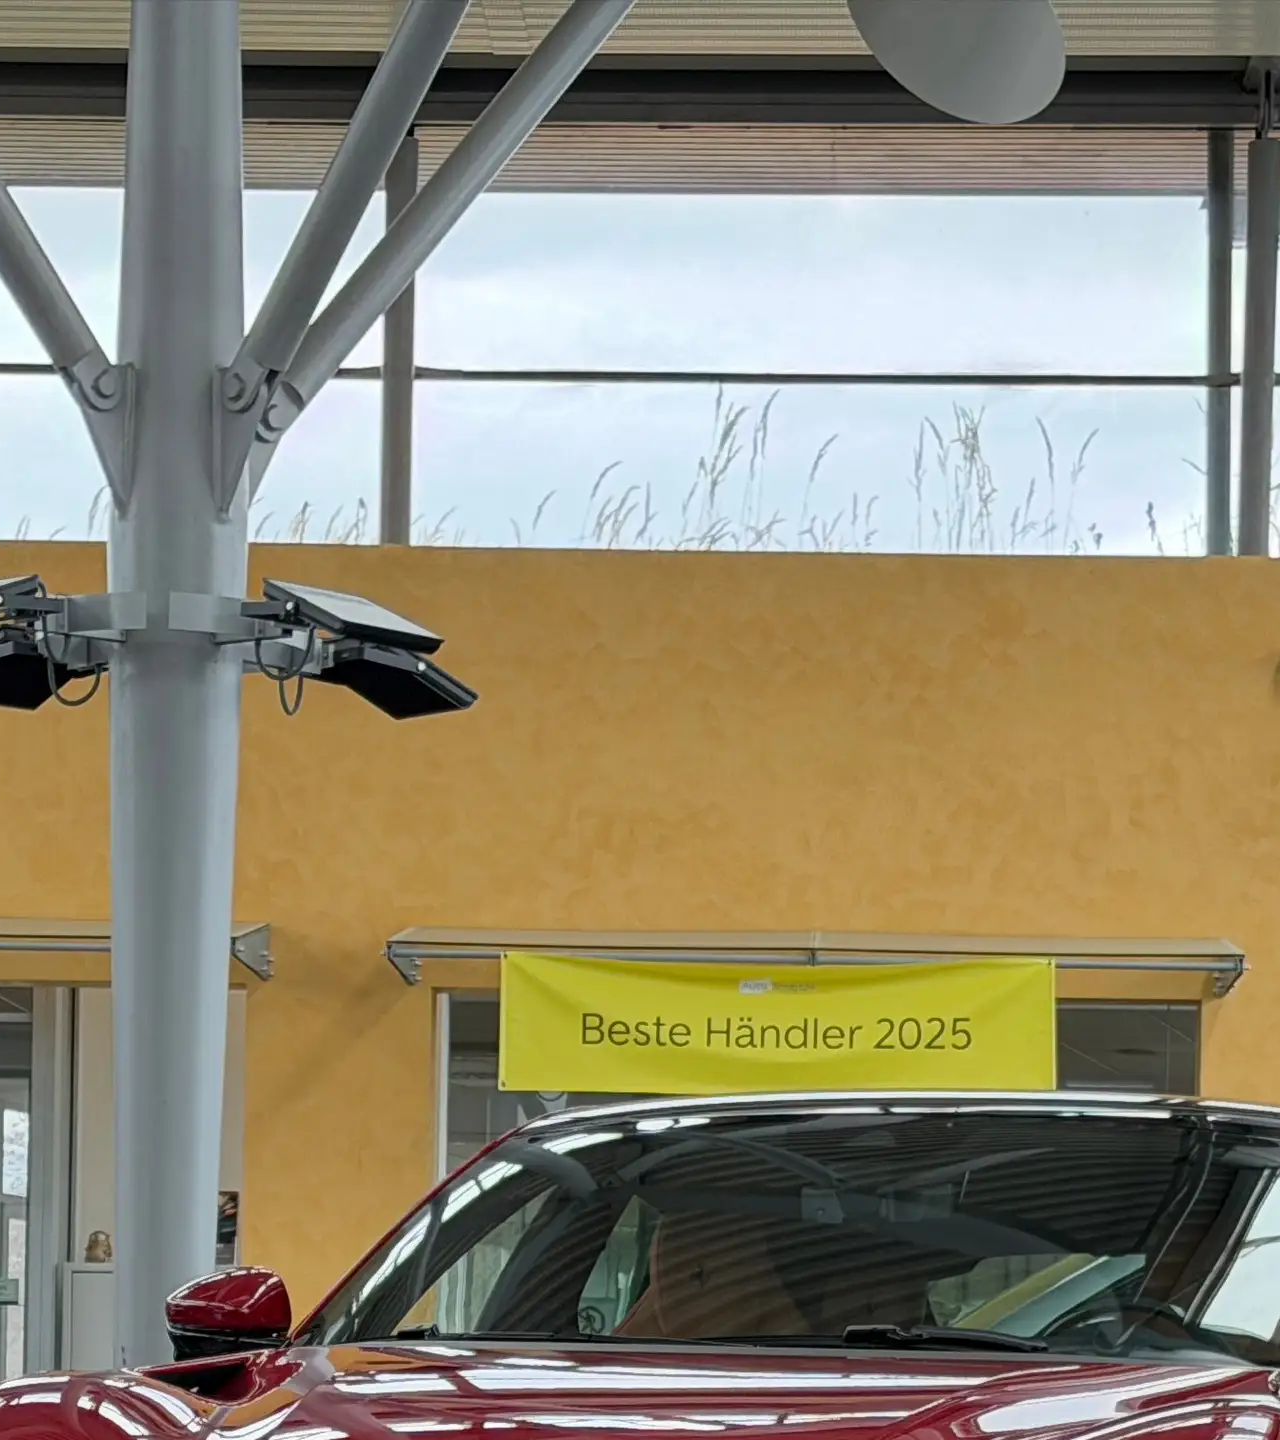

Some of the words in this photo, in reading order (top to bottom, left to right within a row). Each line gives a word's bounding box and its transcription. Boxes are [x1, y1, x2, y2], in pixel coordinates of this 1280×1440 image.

[581, 1012, 691, 1048] Beste
[706, 1014, 863, 1050] Händler
[873, 1017, 972, 1051] 2025
